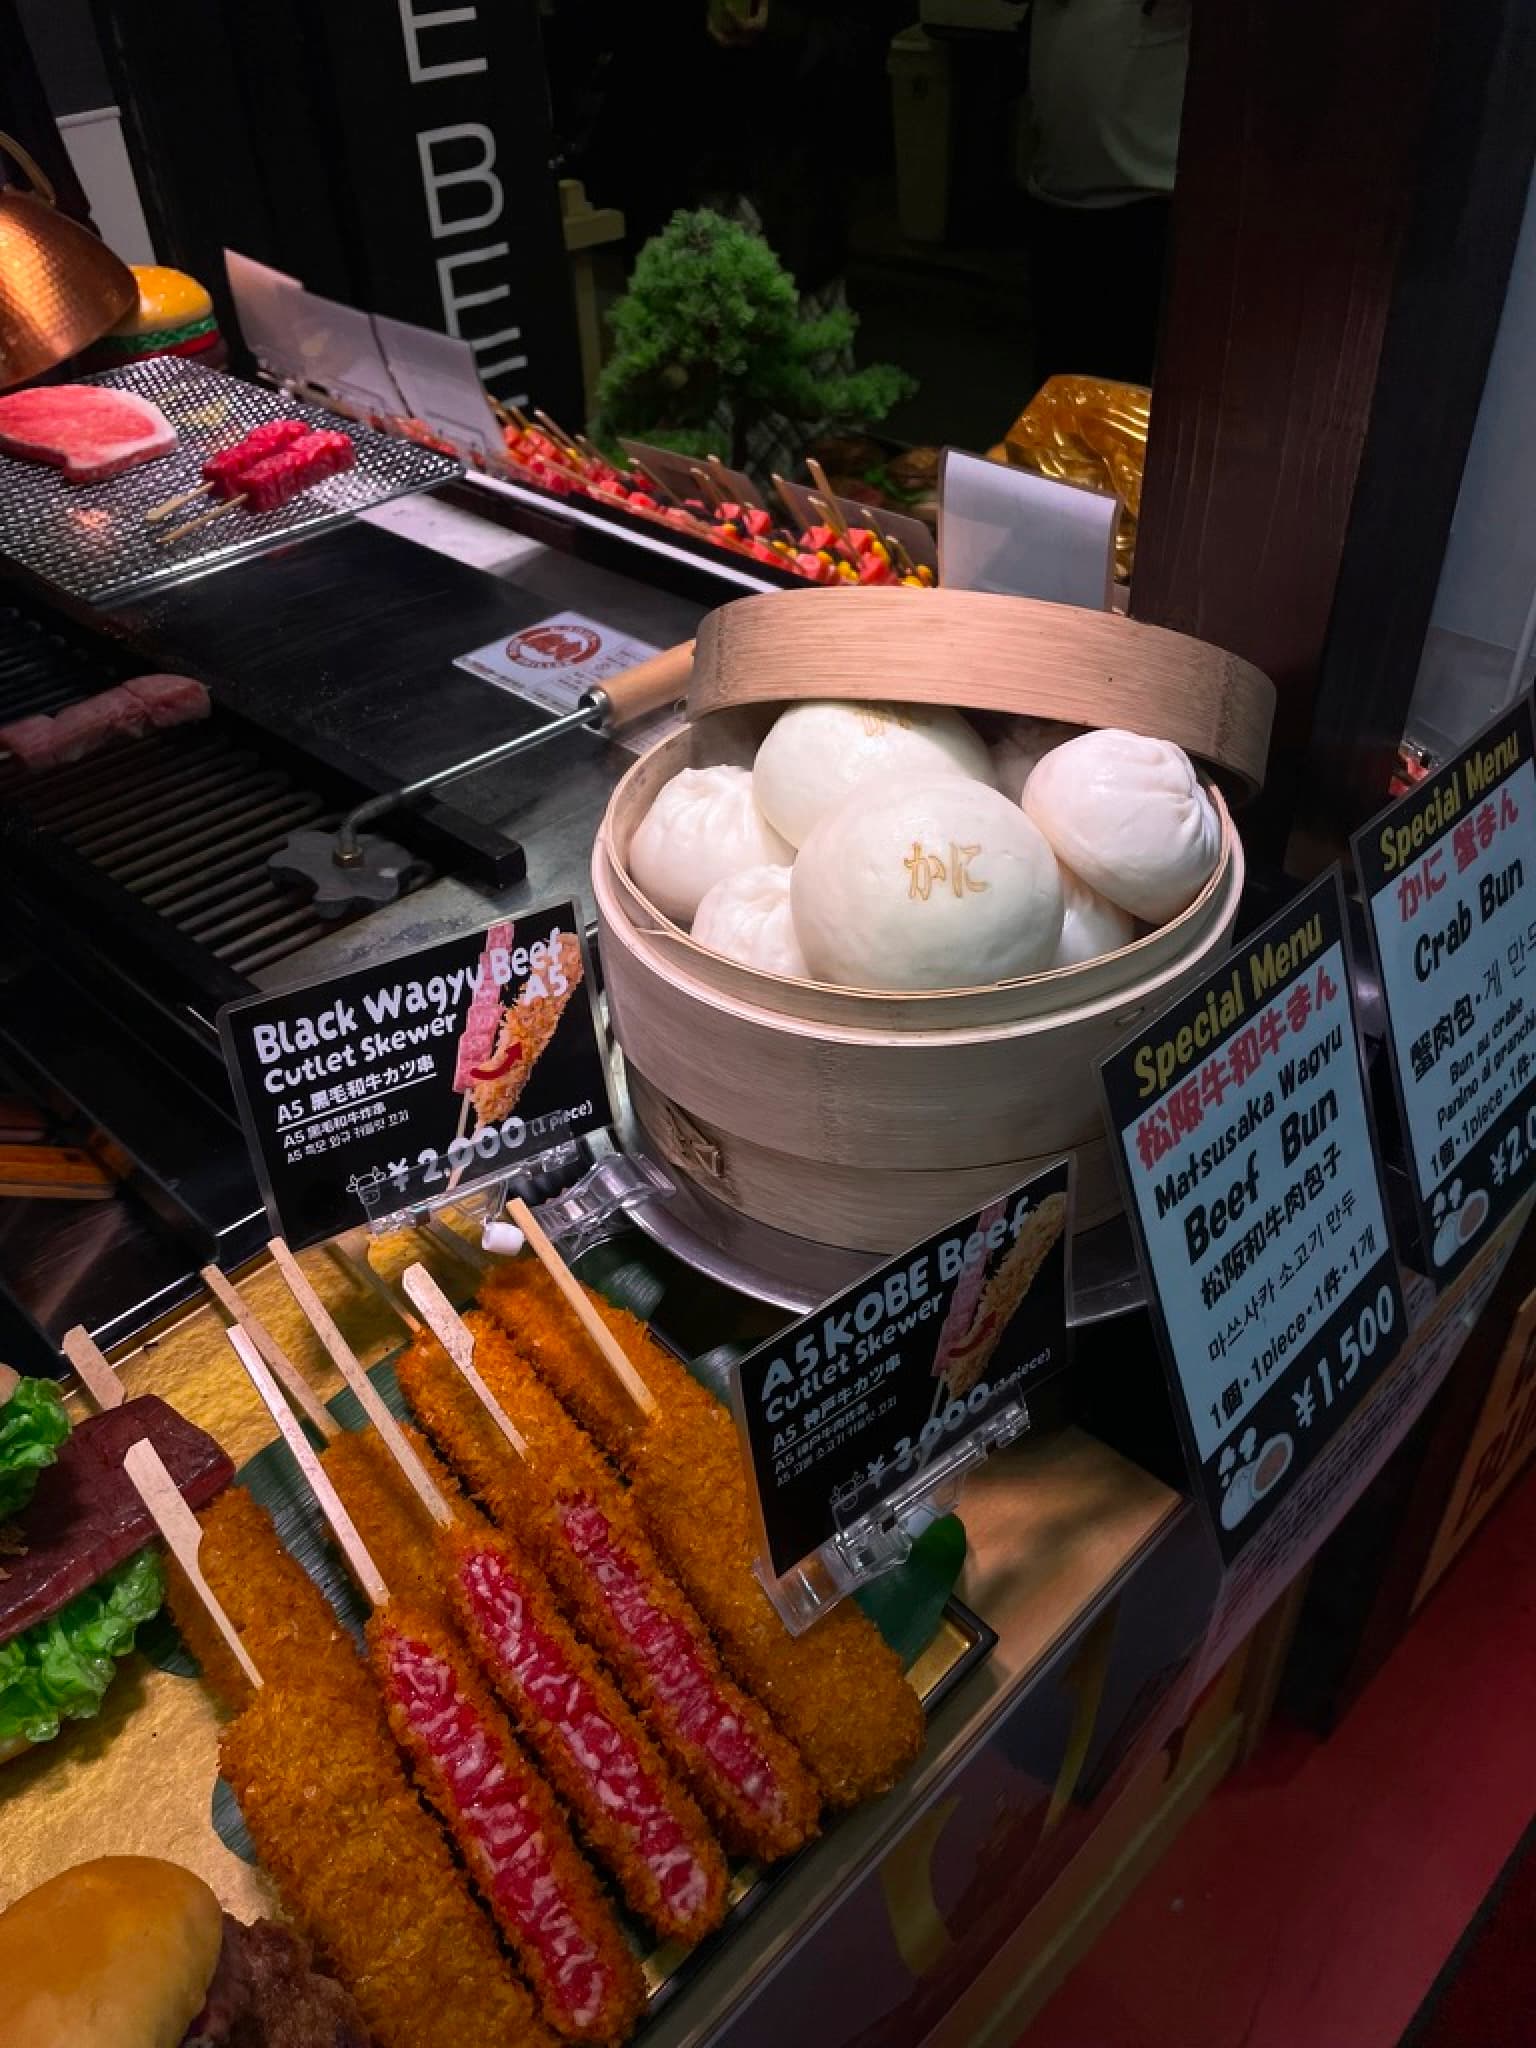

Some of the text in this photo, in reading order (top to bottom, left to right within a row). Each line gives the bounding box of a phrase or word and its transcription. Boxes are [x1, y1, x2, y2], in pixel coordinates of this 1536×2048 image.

[1380, 730, 1519, 872] Special Menu
[903, 841, 989, 900] かに
[1398, 849, 1447, 922] かに
[1414, 857, 1525, 983] Crab Bun
[253, 927, 562, 1065] Black Wagyu Beef
[524, 965, 568, 1004] A5
[1134, 912, 1323, 1097] Special Menu
[264, 1012, 458, 1094] Cutlet Skewer
[278, 1099, 304, 1124] A5
[1135, 965, 1338, 1171] 松阪牛和牛まん
[283, 1129, 305, 1149] A5
[1154, 1024, 1343, 1220] Matsusaka Wagyu
[1184, 1088, 1340, 1266] Beef Bun
[939, 1195, 1031, 1282] Beef
[1201, 1141, 1342, 1310] 松阪和牛肉包子
[1208, 1188, 1357, 1360] 마쓰사카 소고기 만두
[765, 1291, 944, 1424] Cutlet Skewer
[773, 1423, 797, 1453] A5
